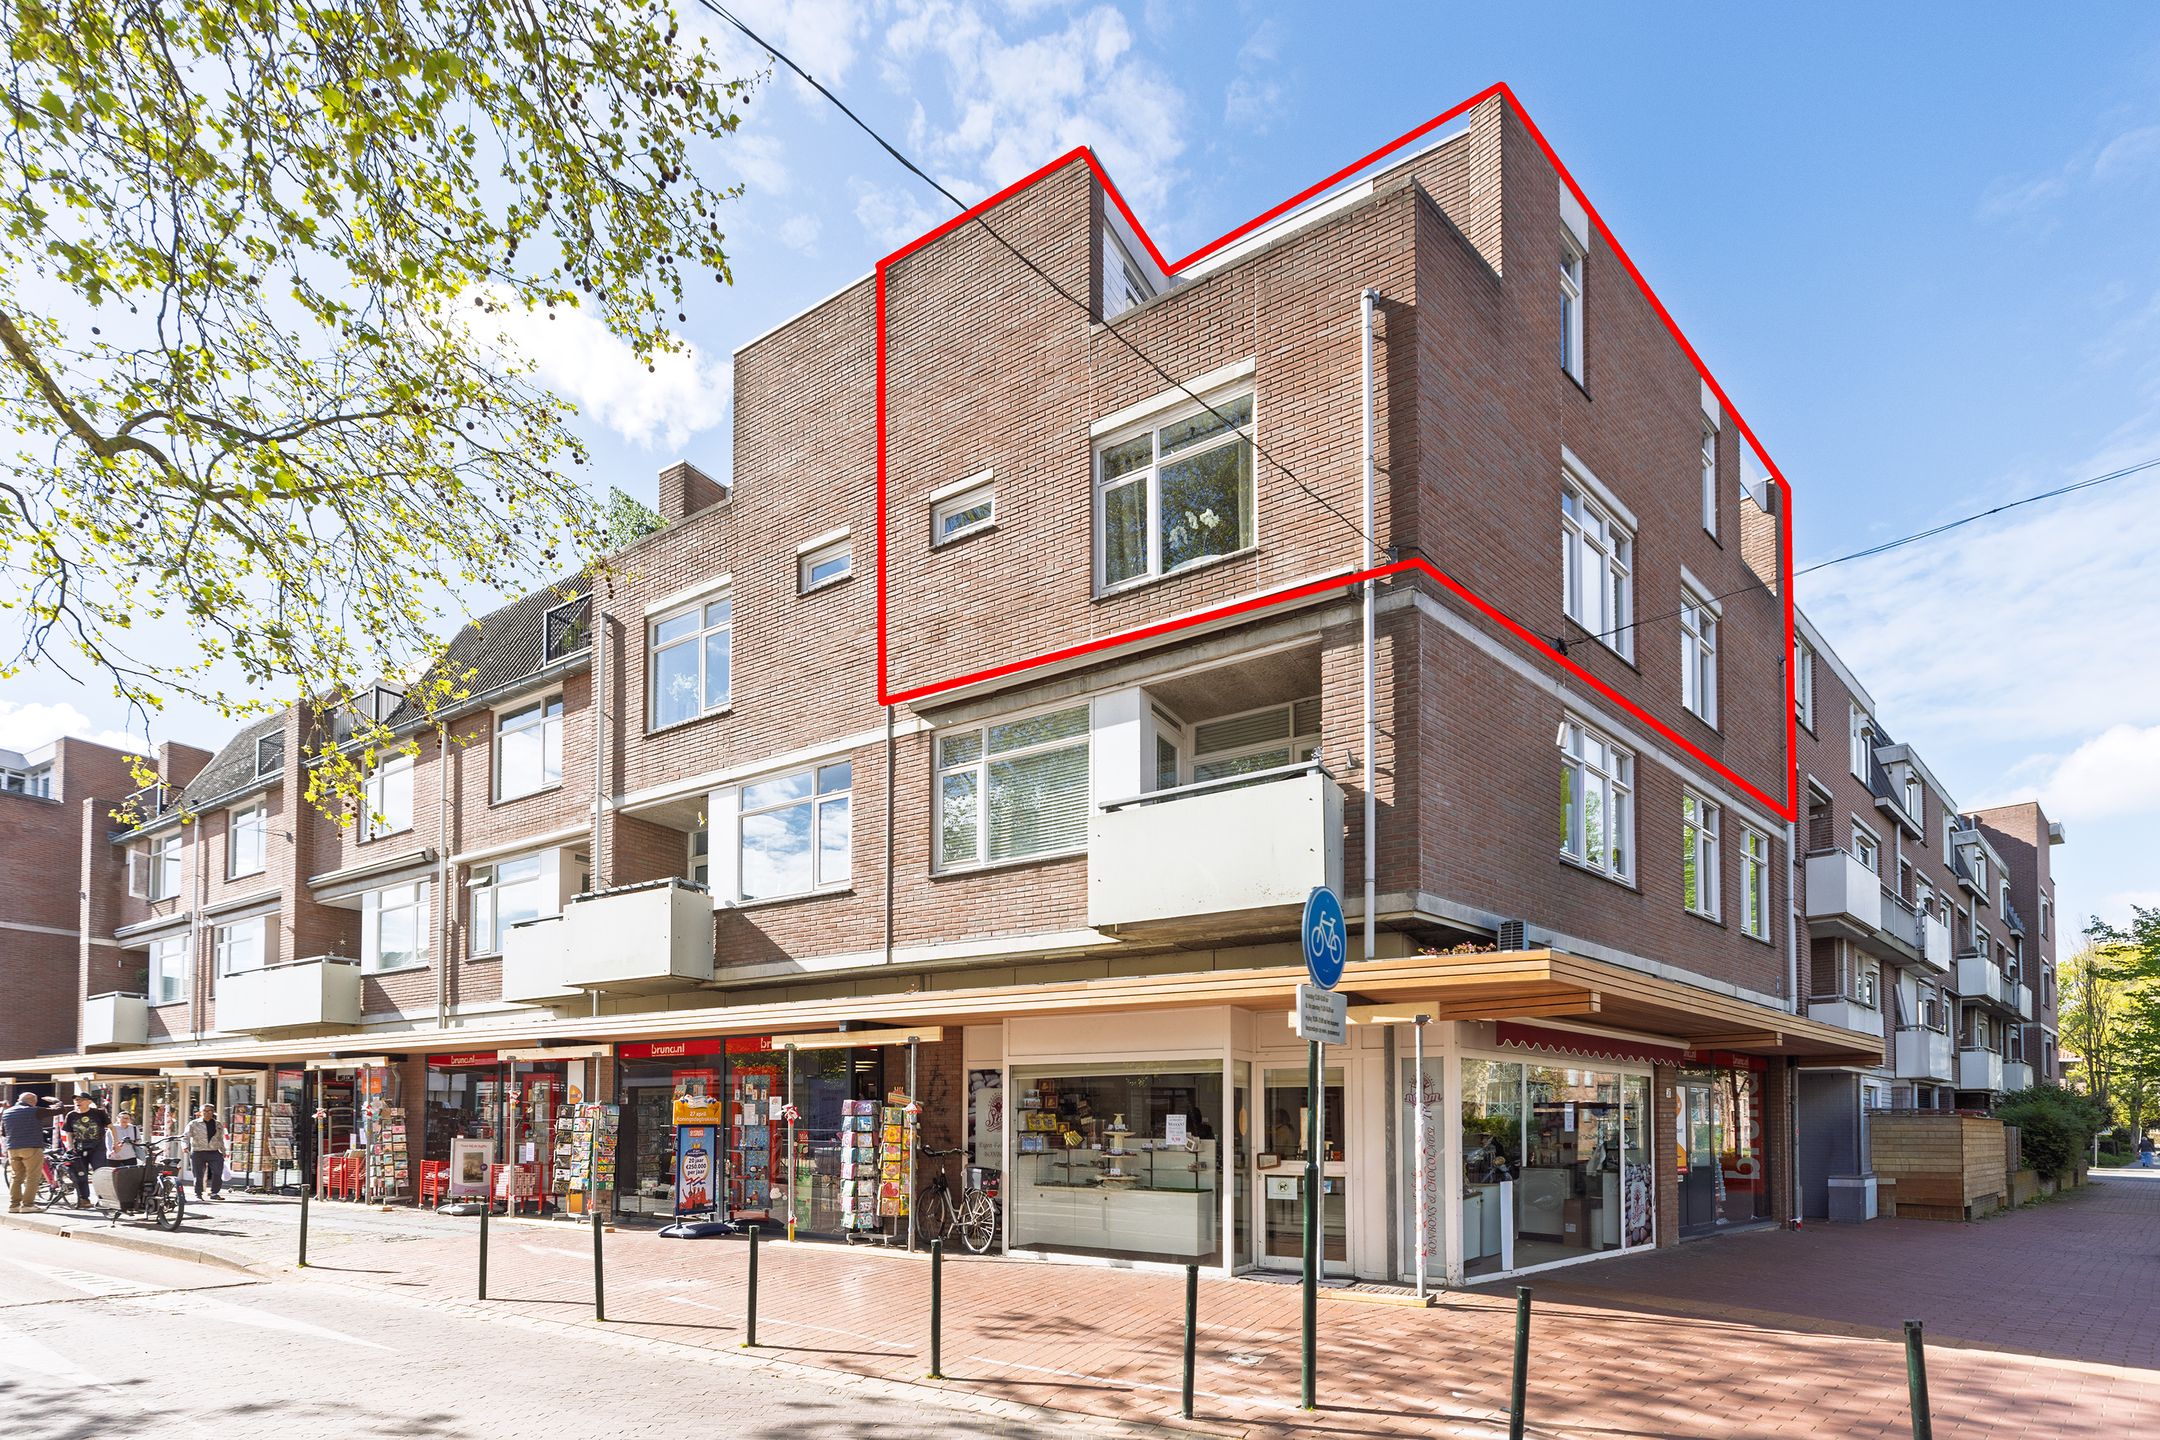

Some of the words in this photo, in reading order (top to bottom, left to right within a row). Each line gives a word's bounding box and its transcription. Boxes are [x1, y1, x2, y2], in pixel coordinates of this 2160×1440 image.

[651, 1043, 685, 1055] bruna.nl
[696, 1111, 707, 1119] april
[1724, 1072, 1761, 1180] bruna
[1427, 1206, 1438, 1256] BONBONS
